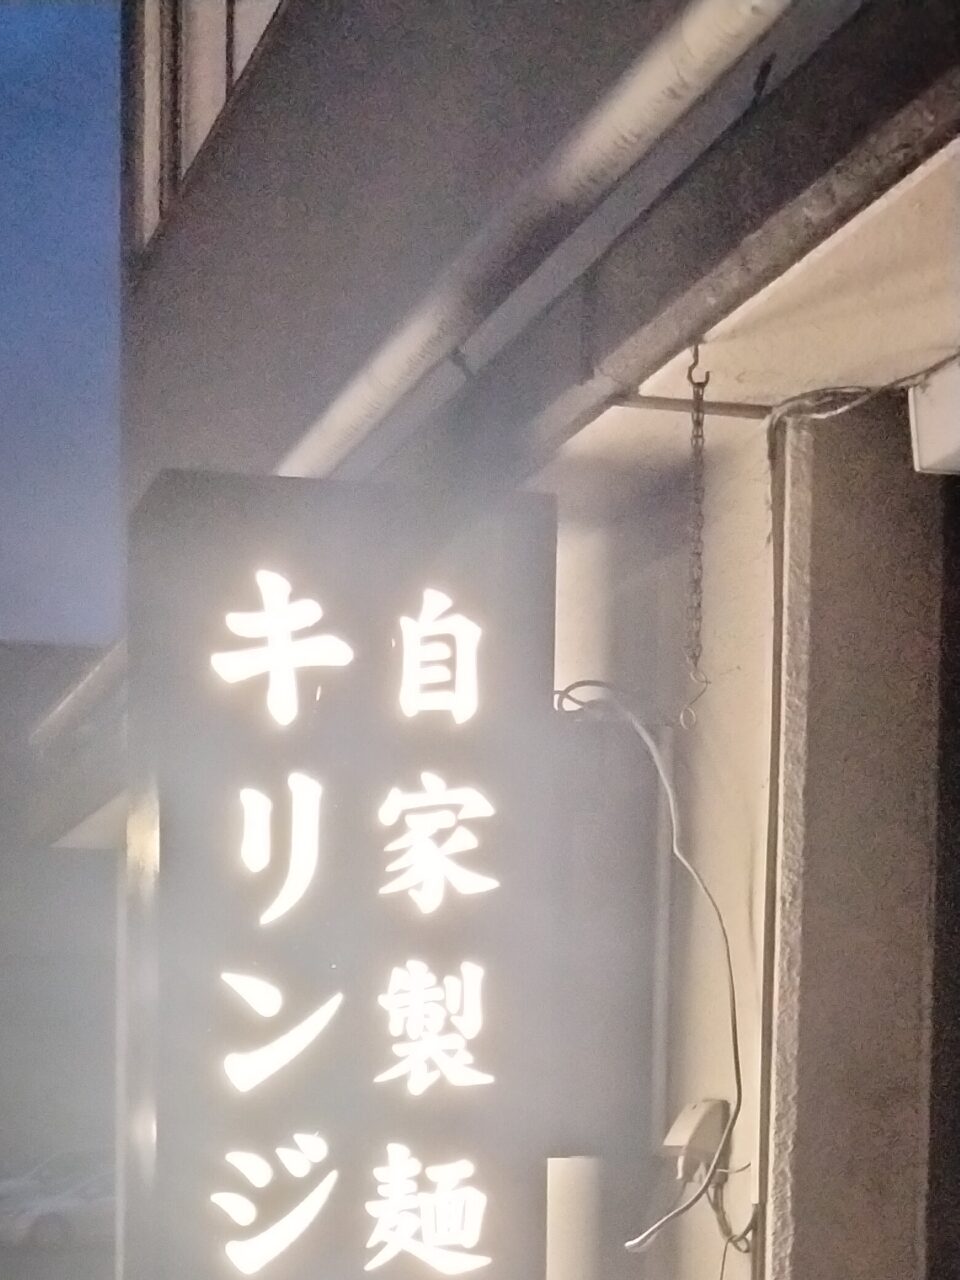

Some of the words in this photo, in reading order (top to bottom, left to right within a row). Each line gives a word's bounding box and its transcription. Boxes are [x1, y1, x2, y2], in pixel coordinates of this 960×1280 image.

[210, 568, 354, 1276] キリンジ
[363, 587, 500, 1277] 自家製麺
